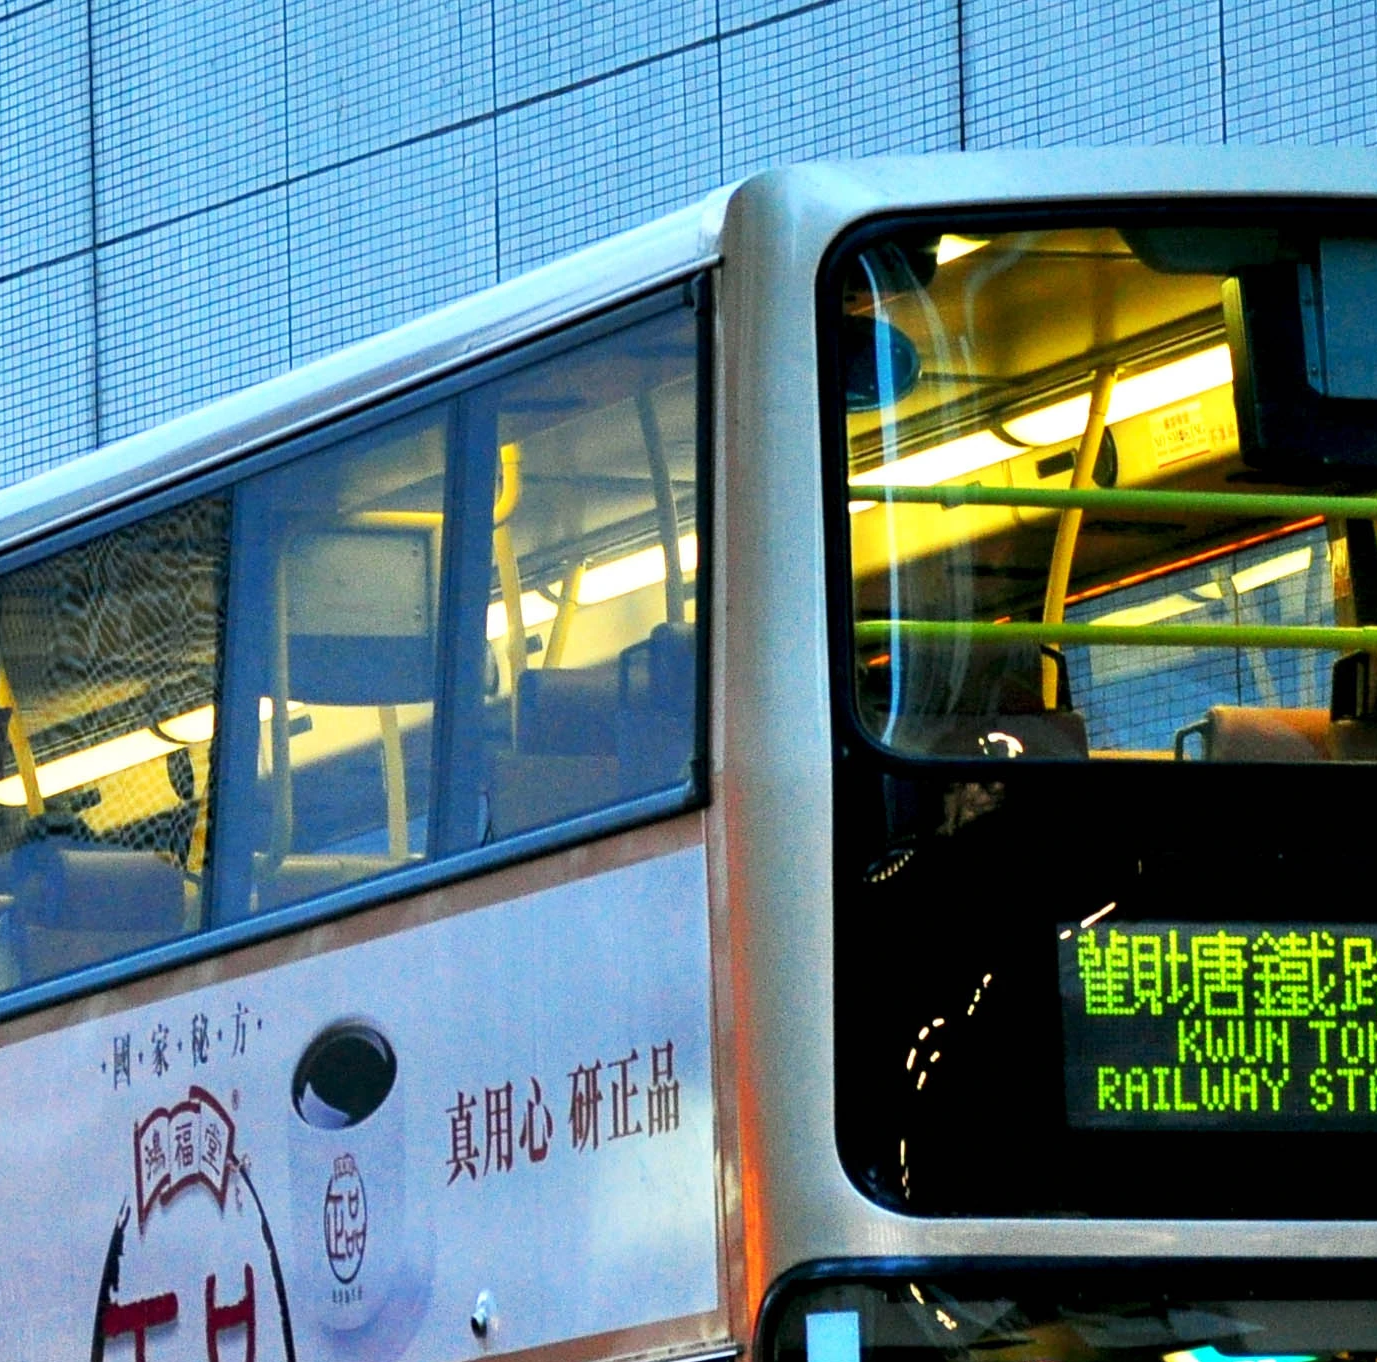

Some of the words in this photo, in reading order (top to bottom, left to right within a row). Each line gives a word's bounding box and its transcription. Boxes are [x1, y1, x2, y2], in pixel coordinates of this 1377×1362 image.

[1177, 1020, 1291, 1064] KWUN
[1096, 1067, 1291, 1112] RAILWAY
[445, 1076, 555, 1188] 真用心
[568, 1039, 682, 1153] 研正品
